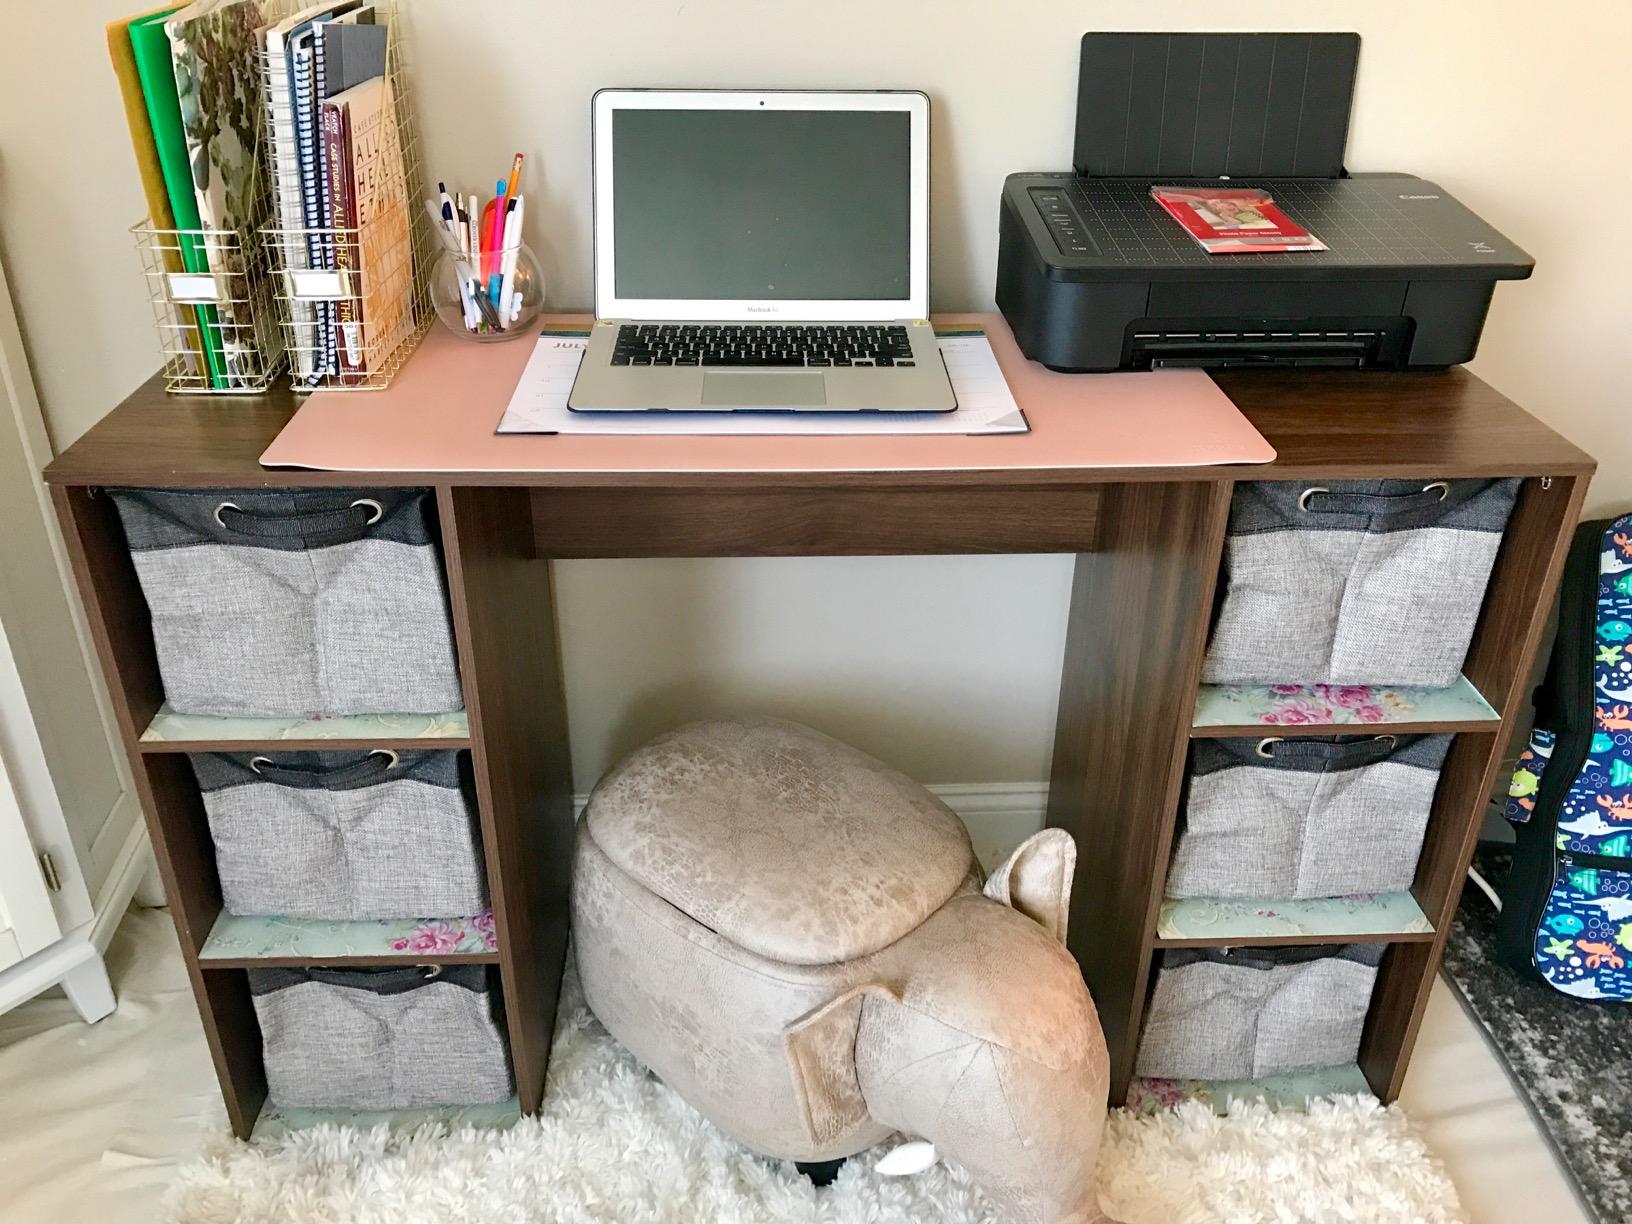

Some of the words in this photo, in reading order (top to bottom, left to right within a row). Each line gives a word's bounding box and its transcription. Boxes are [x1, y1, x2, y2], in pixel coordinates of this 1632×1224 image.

[330, 142, 338, 161] CASE
[331, 163, 341, 192] STUDIES
[334, 193, 342, 202] IN
[333, 203, 346, 244] ALLID
